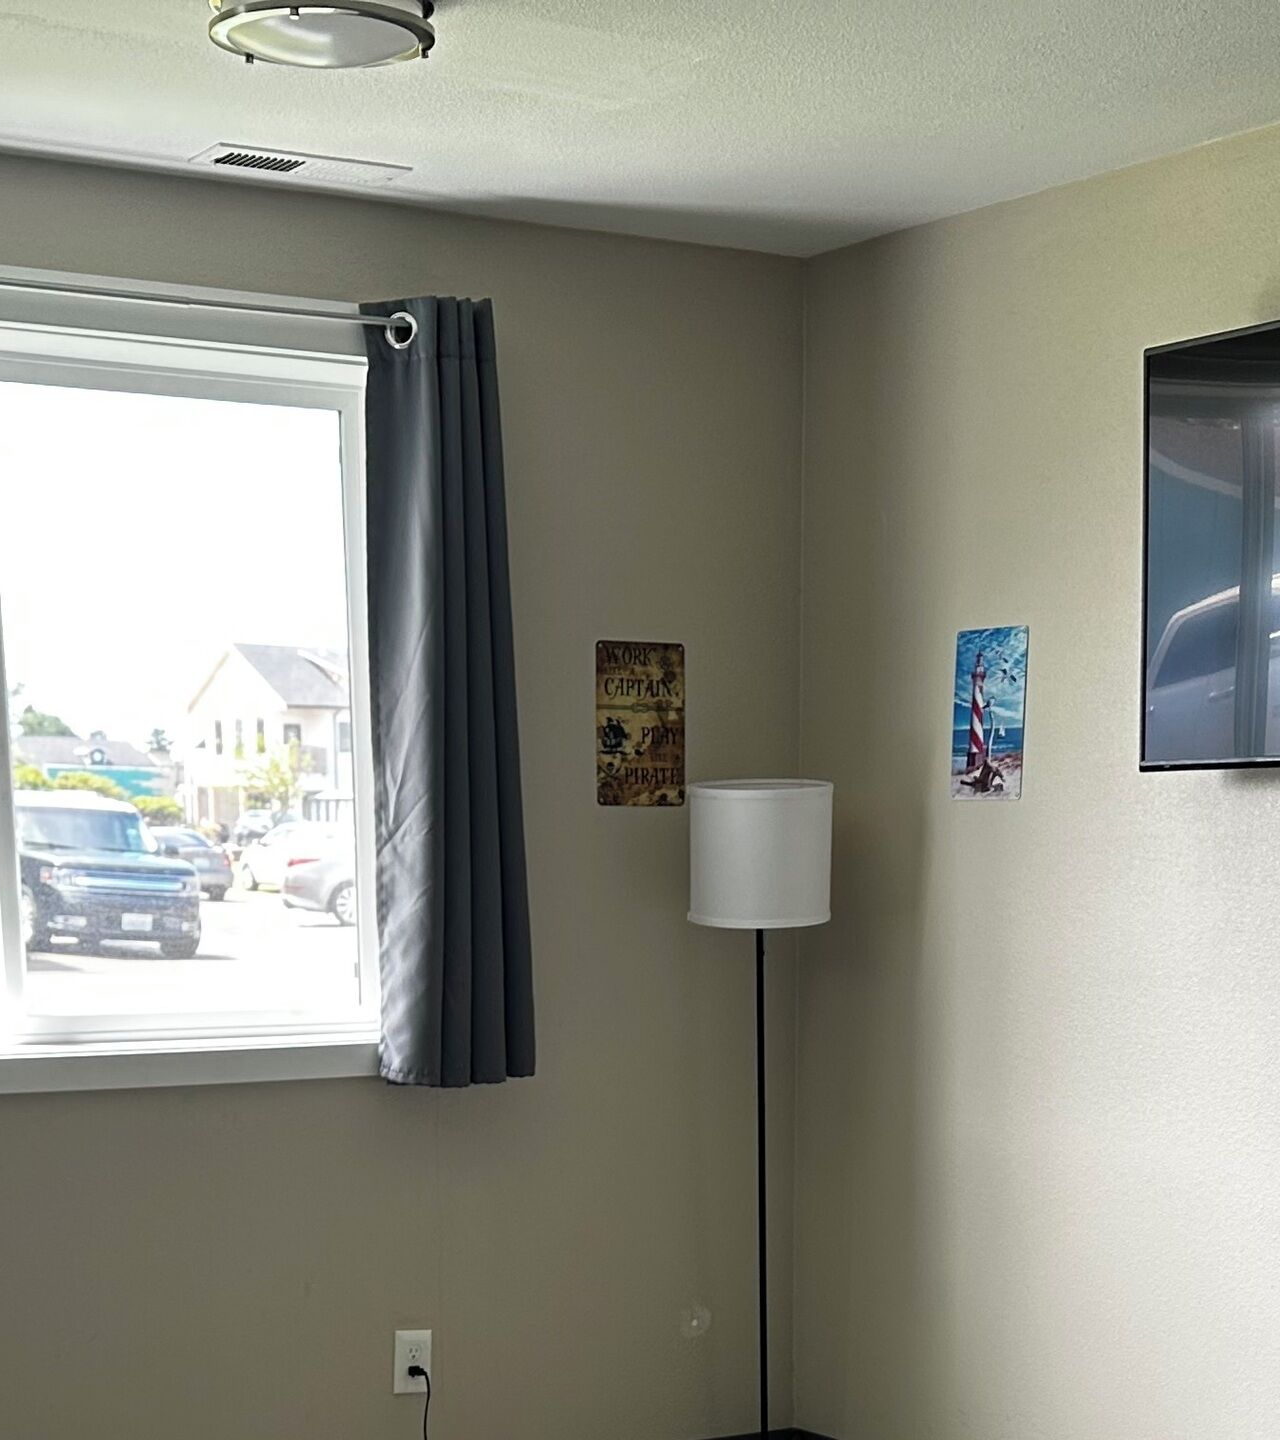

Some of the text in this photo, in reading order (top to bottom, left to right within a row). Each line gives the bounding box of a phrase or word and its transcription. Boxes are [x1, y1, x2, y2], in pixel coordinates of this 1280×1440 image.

[604, 646, 657, 666] WORK
[641, 726, 679, 744] PLAY
[624, 767, 678, 784] PIRATE
